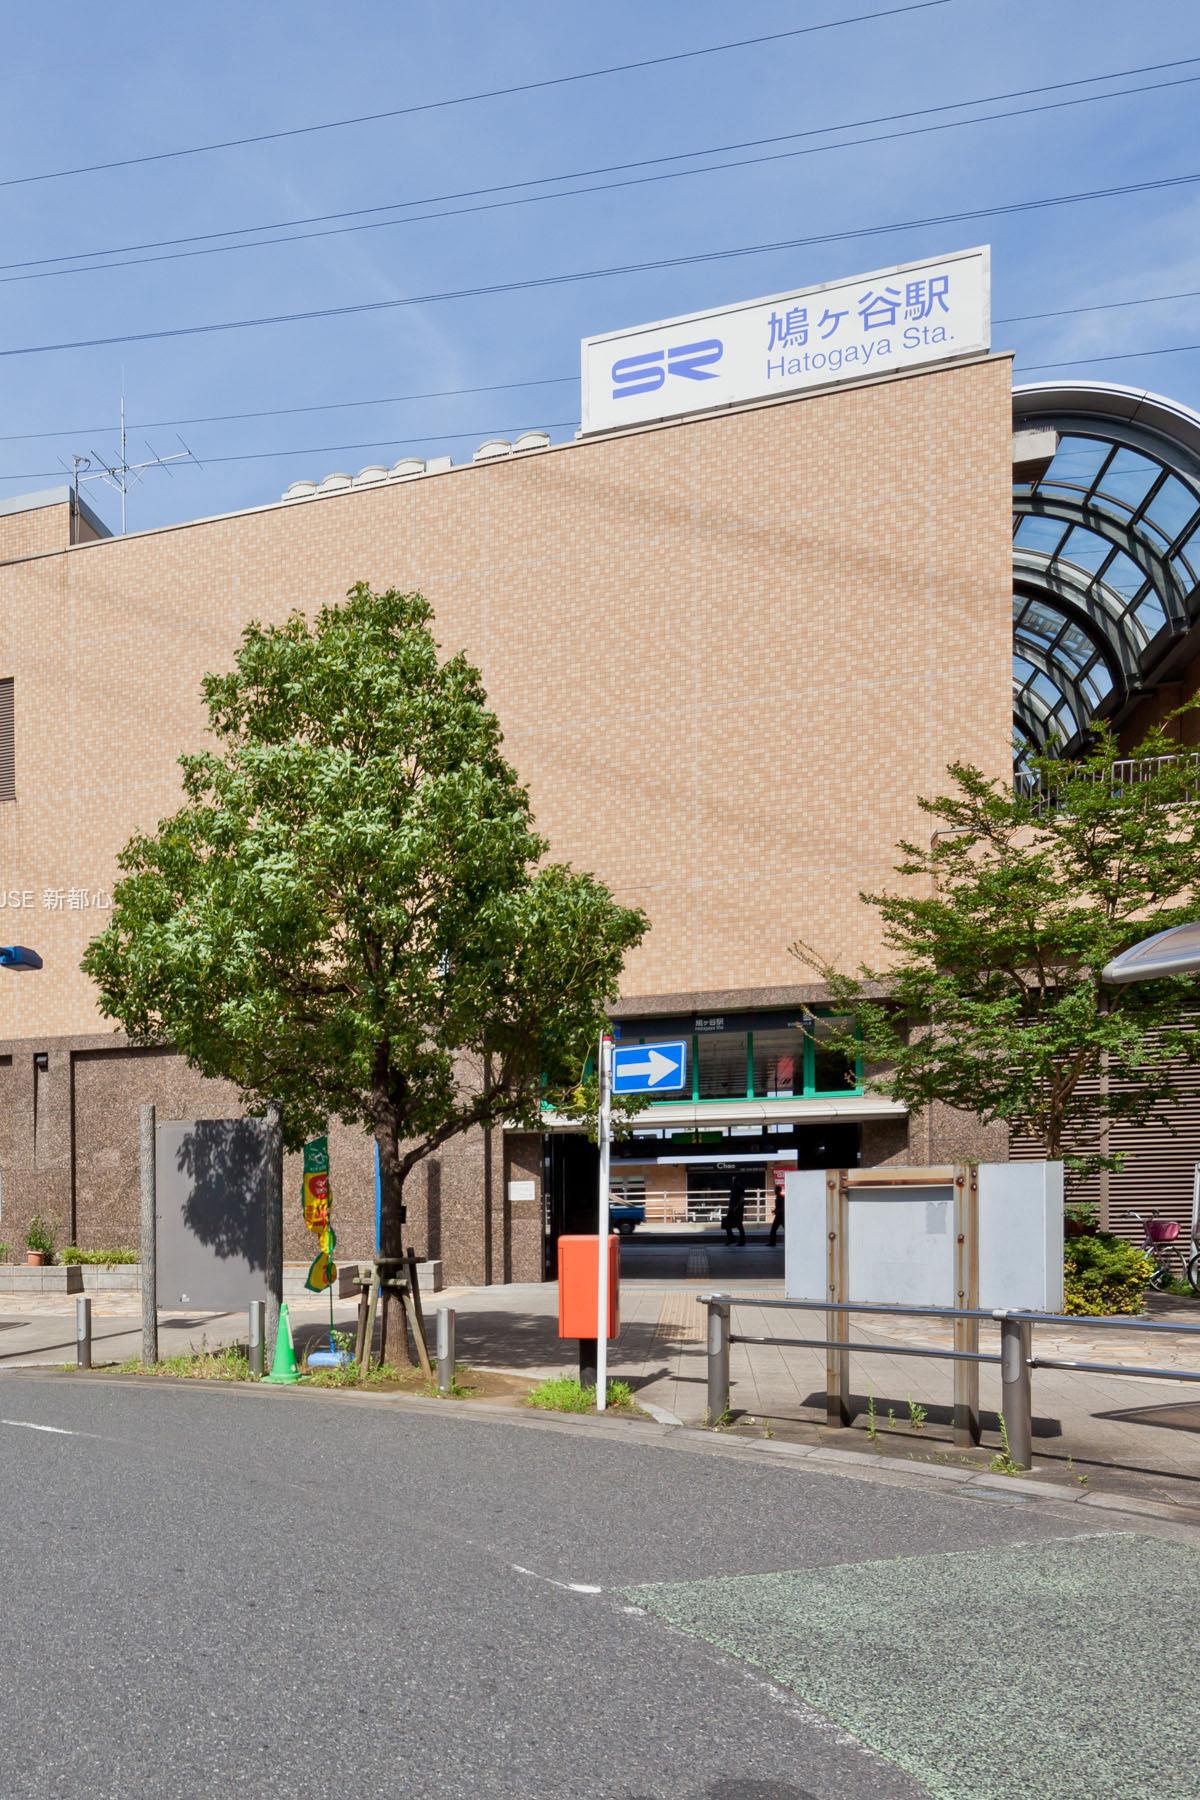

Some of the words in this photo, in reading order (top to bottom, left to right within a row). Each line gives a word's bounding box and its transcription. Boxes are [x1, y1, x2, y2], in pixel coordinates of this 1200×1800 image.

[767, 275, 950, 352] 鳩ヶ谷駅
[611, 338, 724, 400] SR
[767, 339, 892, 379] Hatogaya
[902, 323, 955, 350] Sta.
